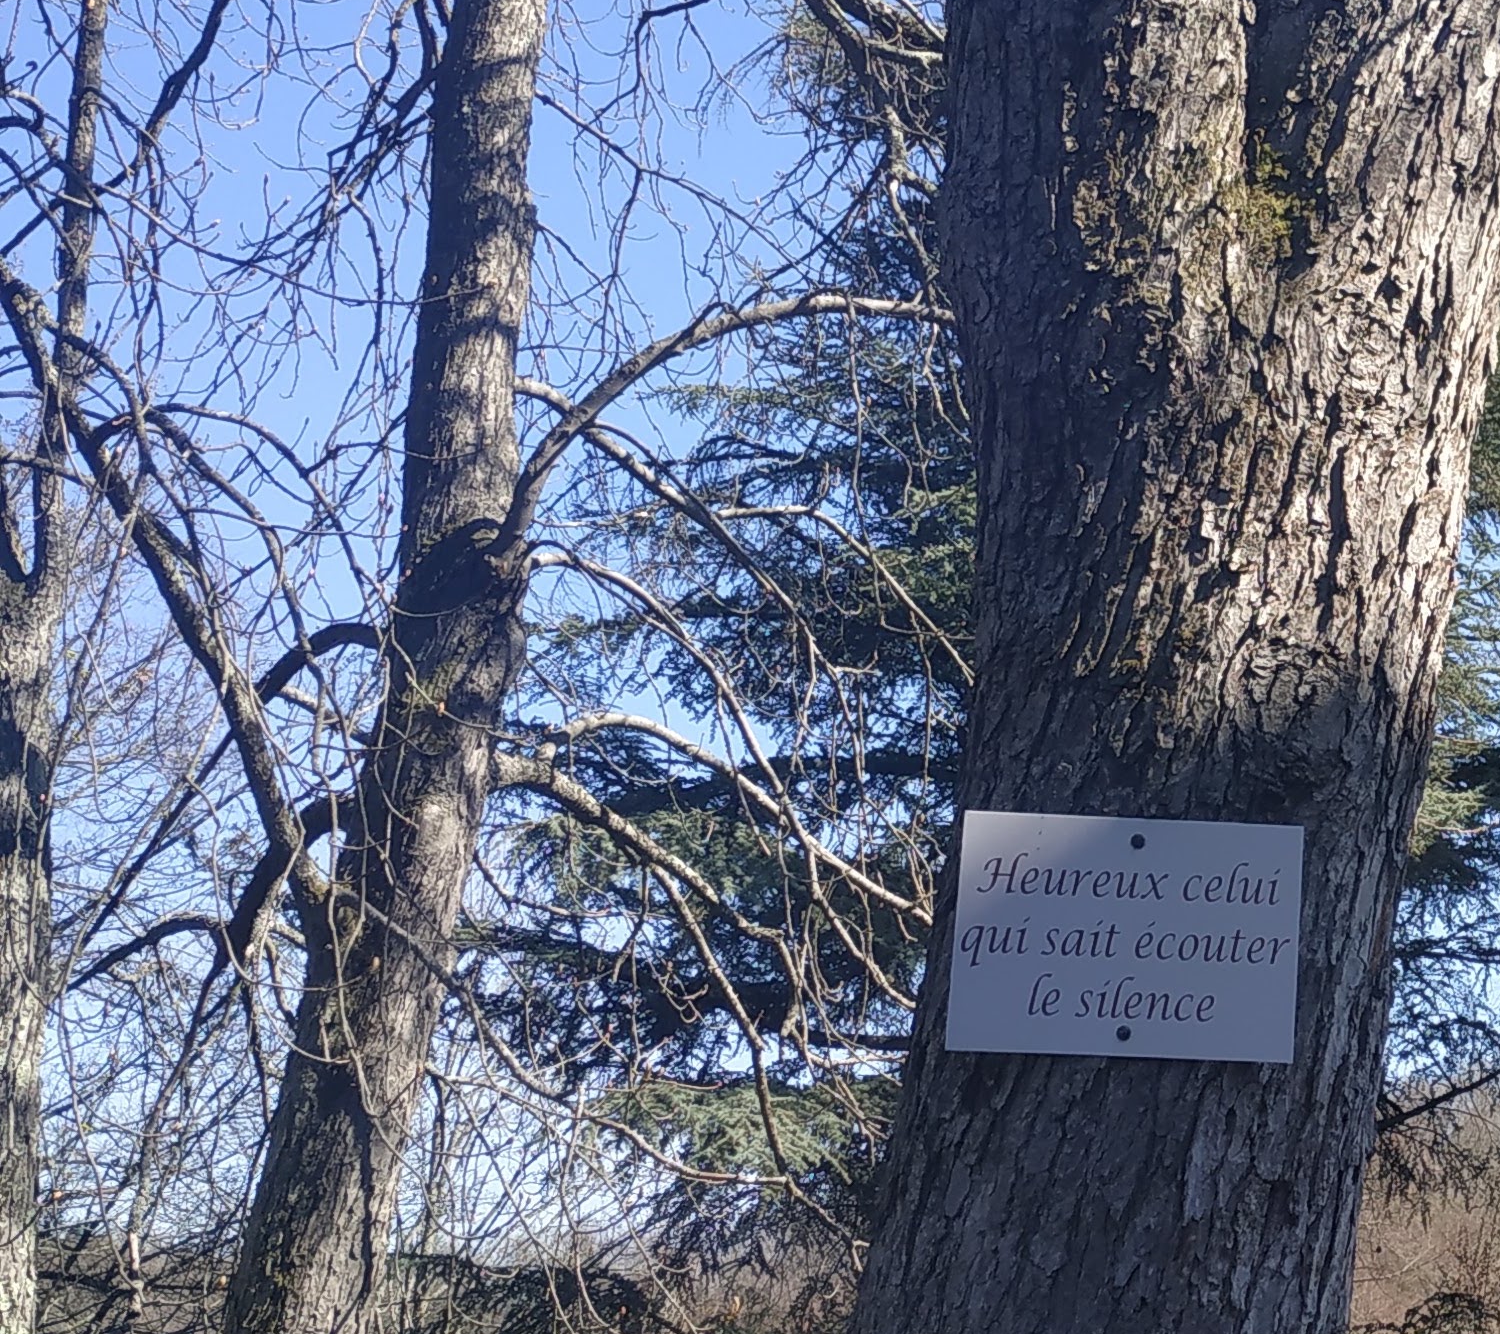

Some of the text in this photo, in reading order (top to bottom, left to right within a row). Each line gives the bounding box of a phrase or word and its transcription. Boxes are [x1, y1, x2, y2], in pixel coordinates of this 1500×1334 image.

[976, 852, 1282, 906] Heureux celui
[960, 916, 1291, 968] qui sait écouter
[1027, 973, 1216, 1022] le silence
